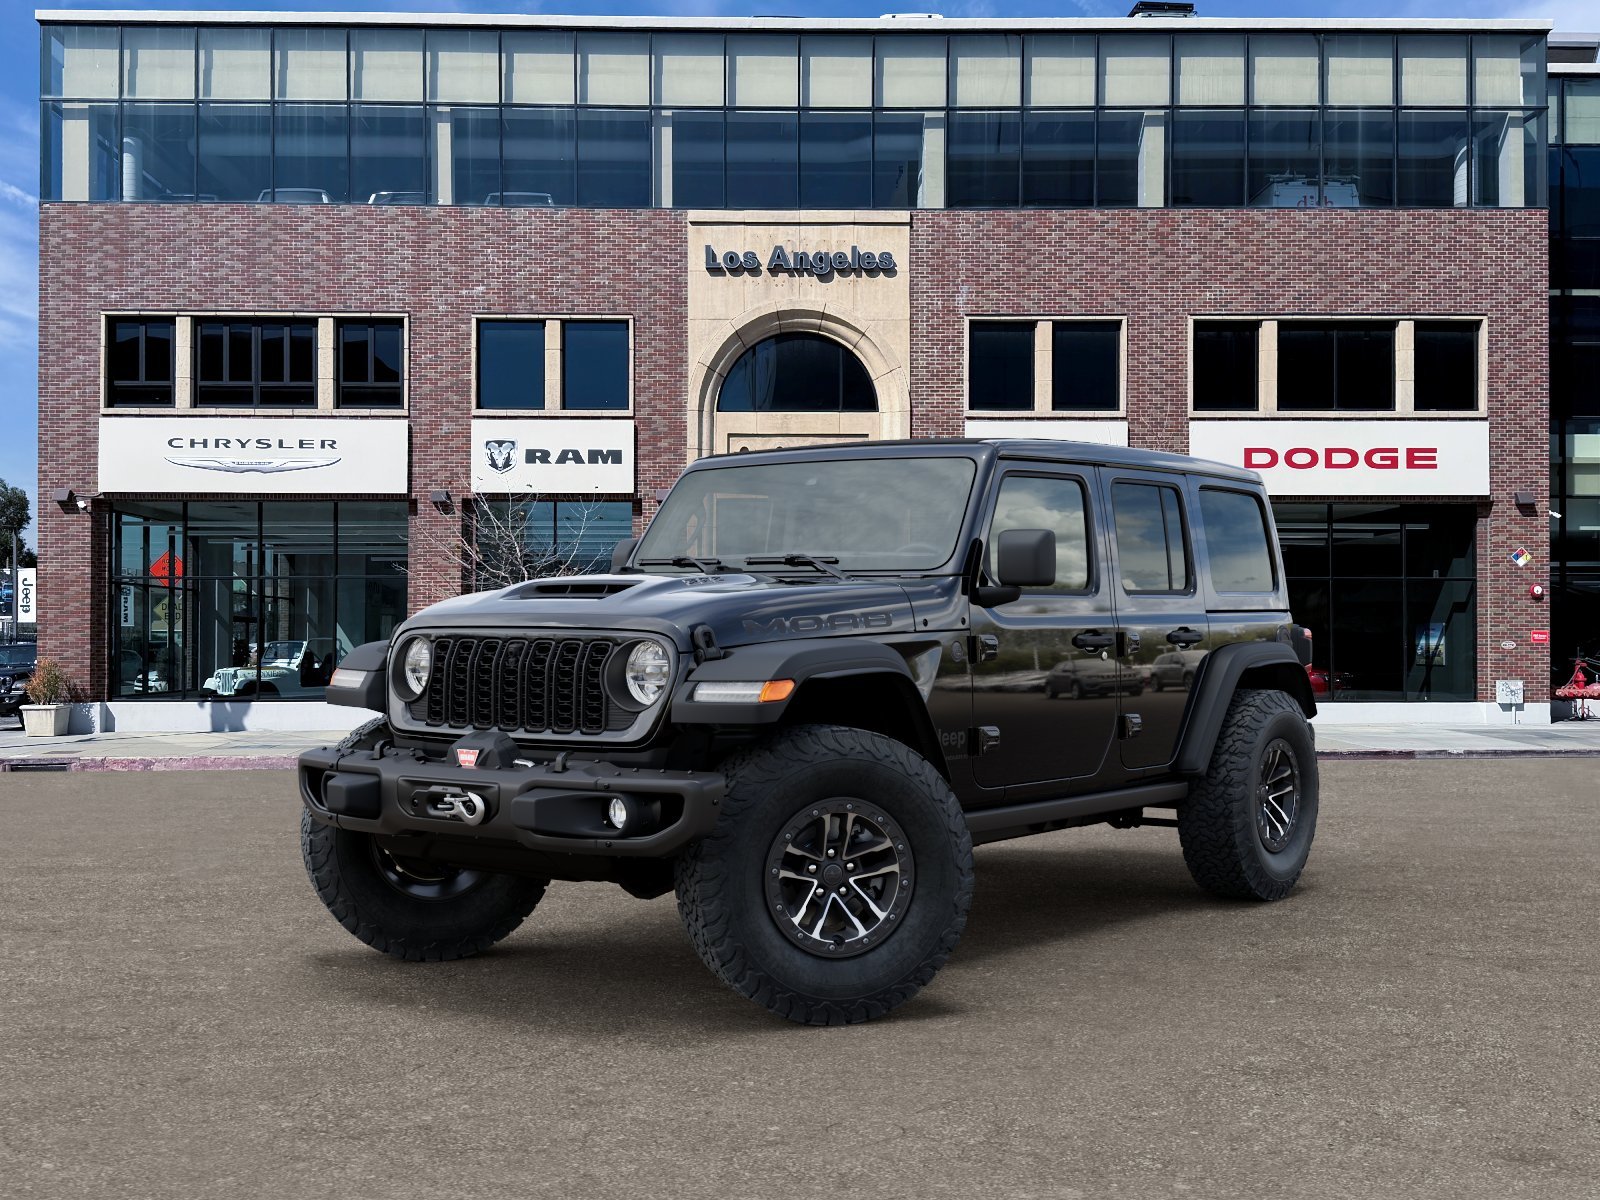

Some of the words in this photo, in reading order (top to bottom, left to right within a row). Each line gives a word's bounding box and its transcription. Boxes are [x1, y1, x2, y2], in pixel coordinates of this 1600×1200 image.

[704, 245, 758, 269] Los
[767, 245, 894, 275] Angeles
[167, 438, 338, 449] CHRYSLER
[525, 449, 622, 464] RAM
[1243, 447, 1438, 469] DODGE
[21, 577, 33, 613] Jeep
[741, 611, 893, 634] MOAB
